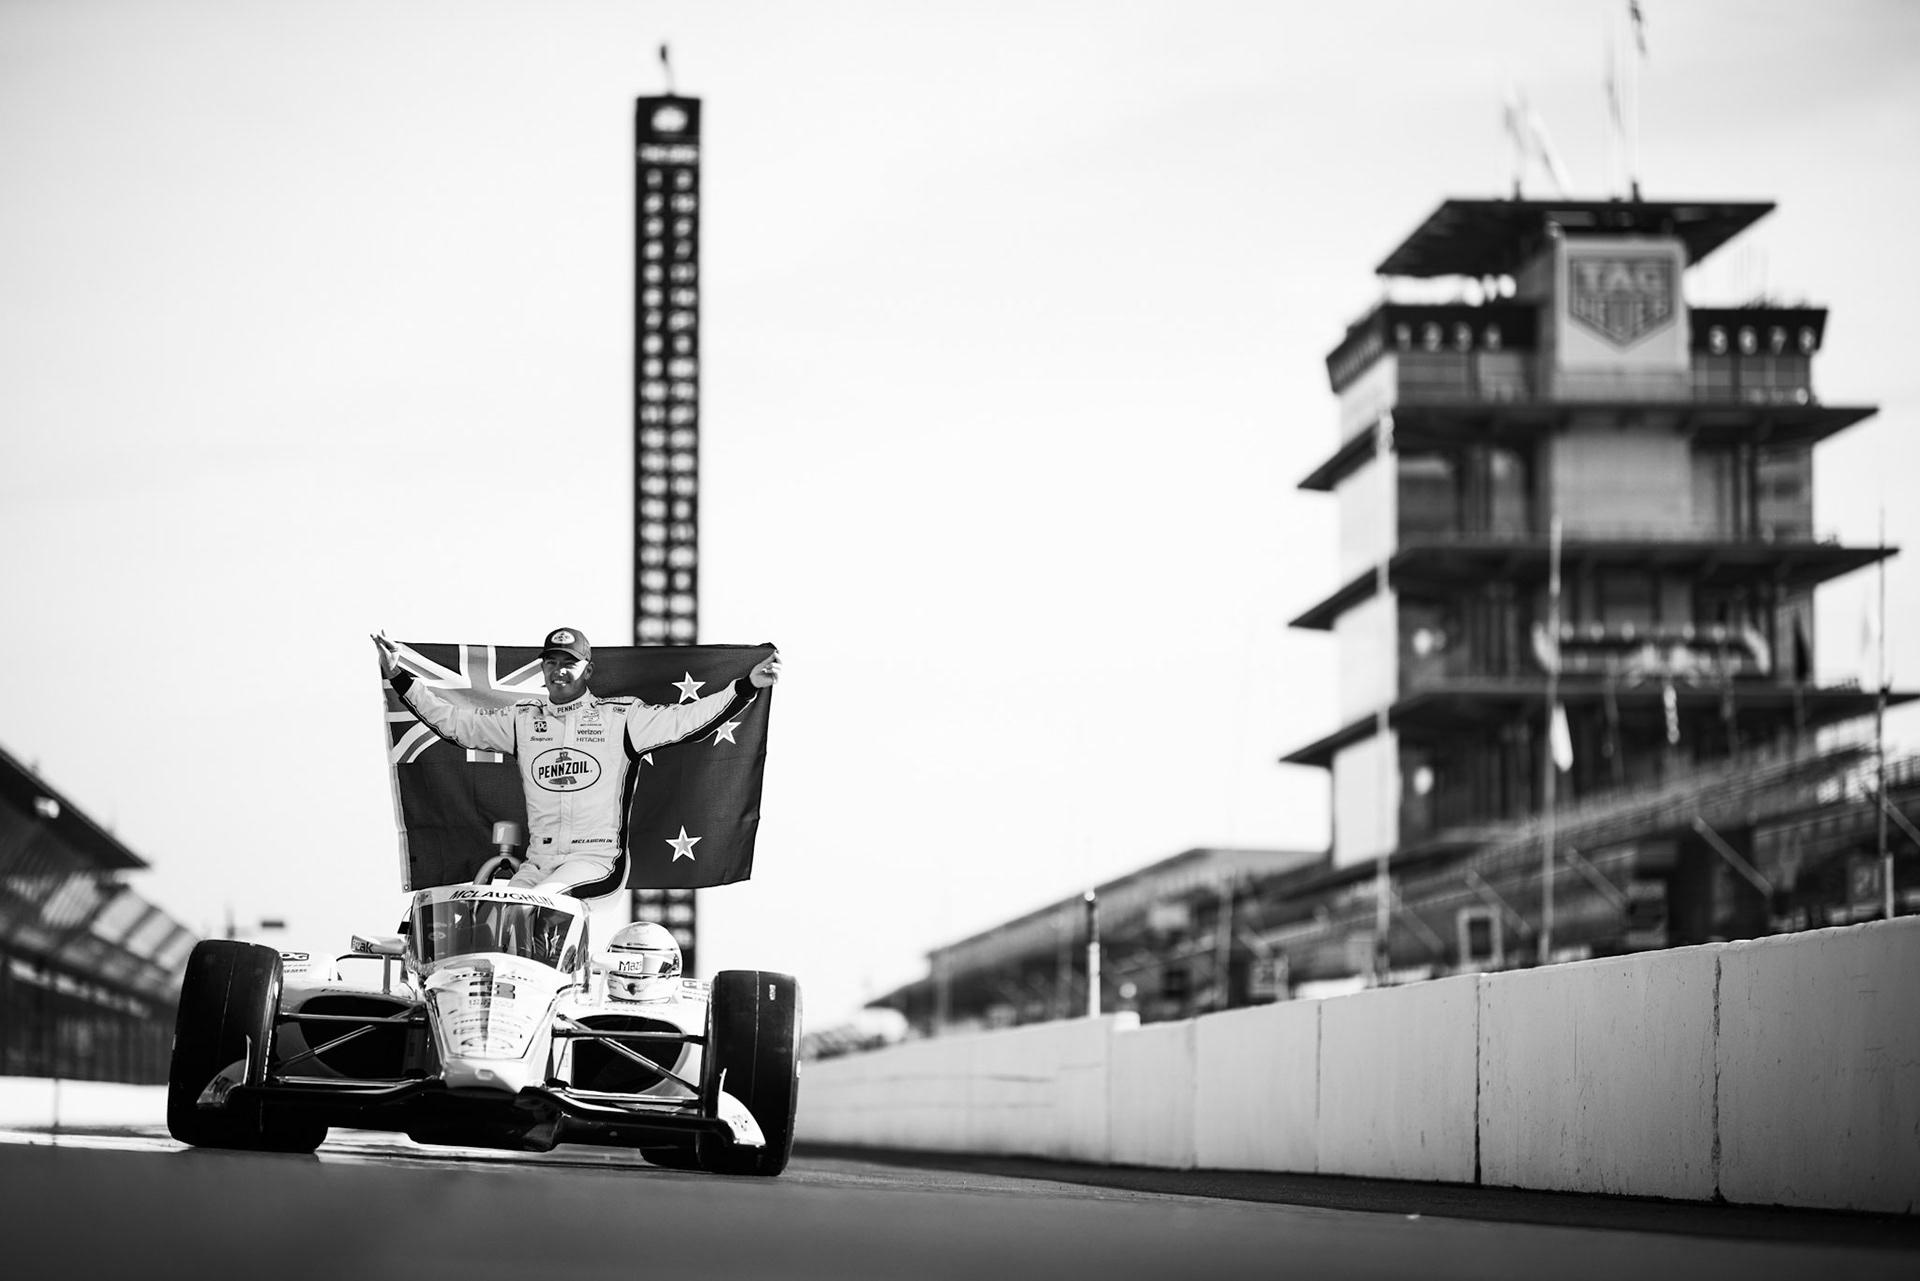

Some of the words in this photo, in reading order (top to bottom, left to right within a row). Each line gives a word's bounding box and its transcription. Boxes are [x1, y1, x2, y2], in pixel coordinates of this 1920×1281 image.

[1578, 262, 1664, 294] TAG
[557, 702, 583, 713] PENNZOIL
[538, 761, 589, 779] PENNZOIL
[450, 890, 555, 907] MCLAUGHLIN
